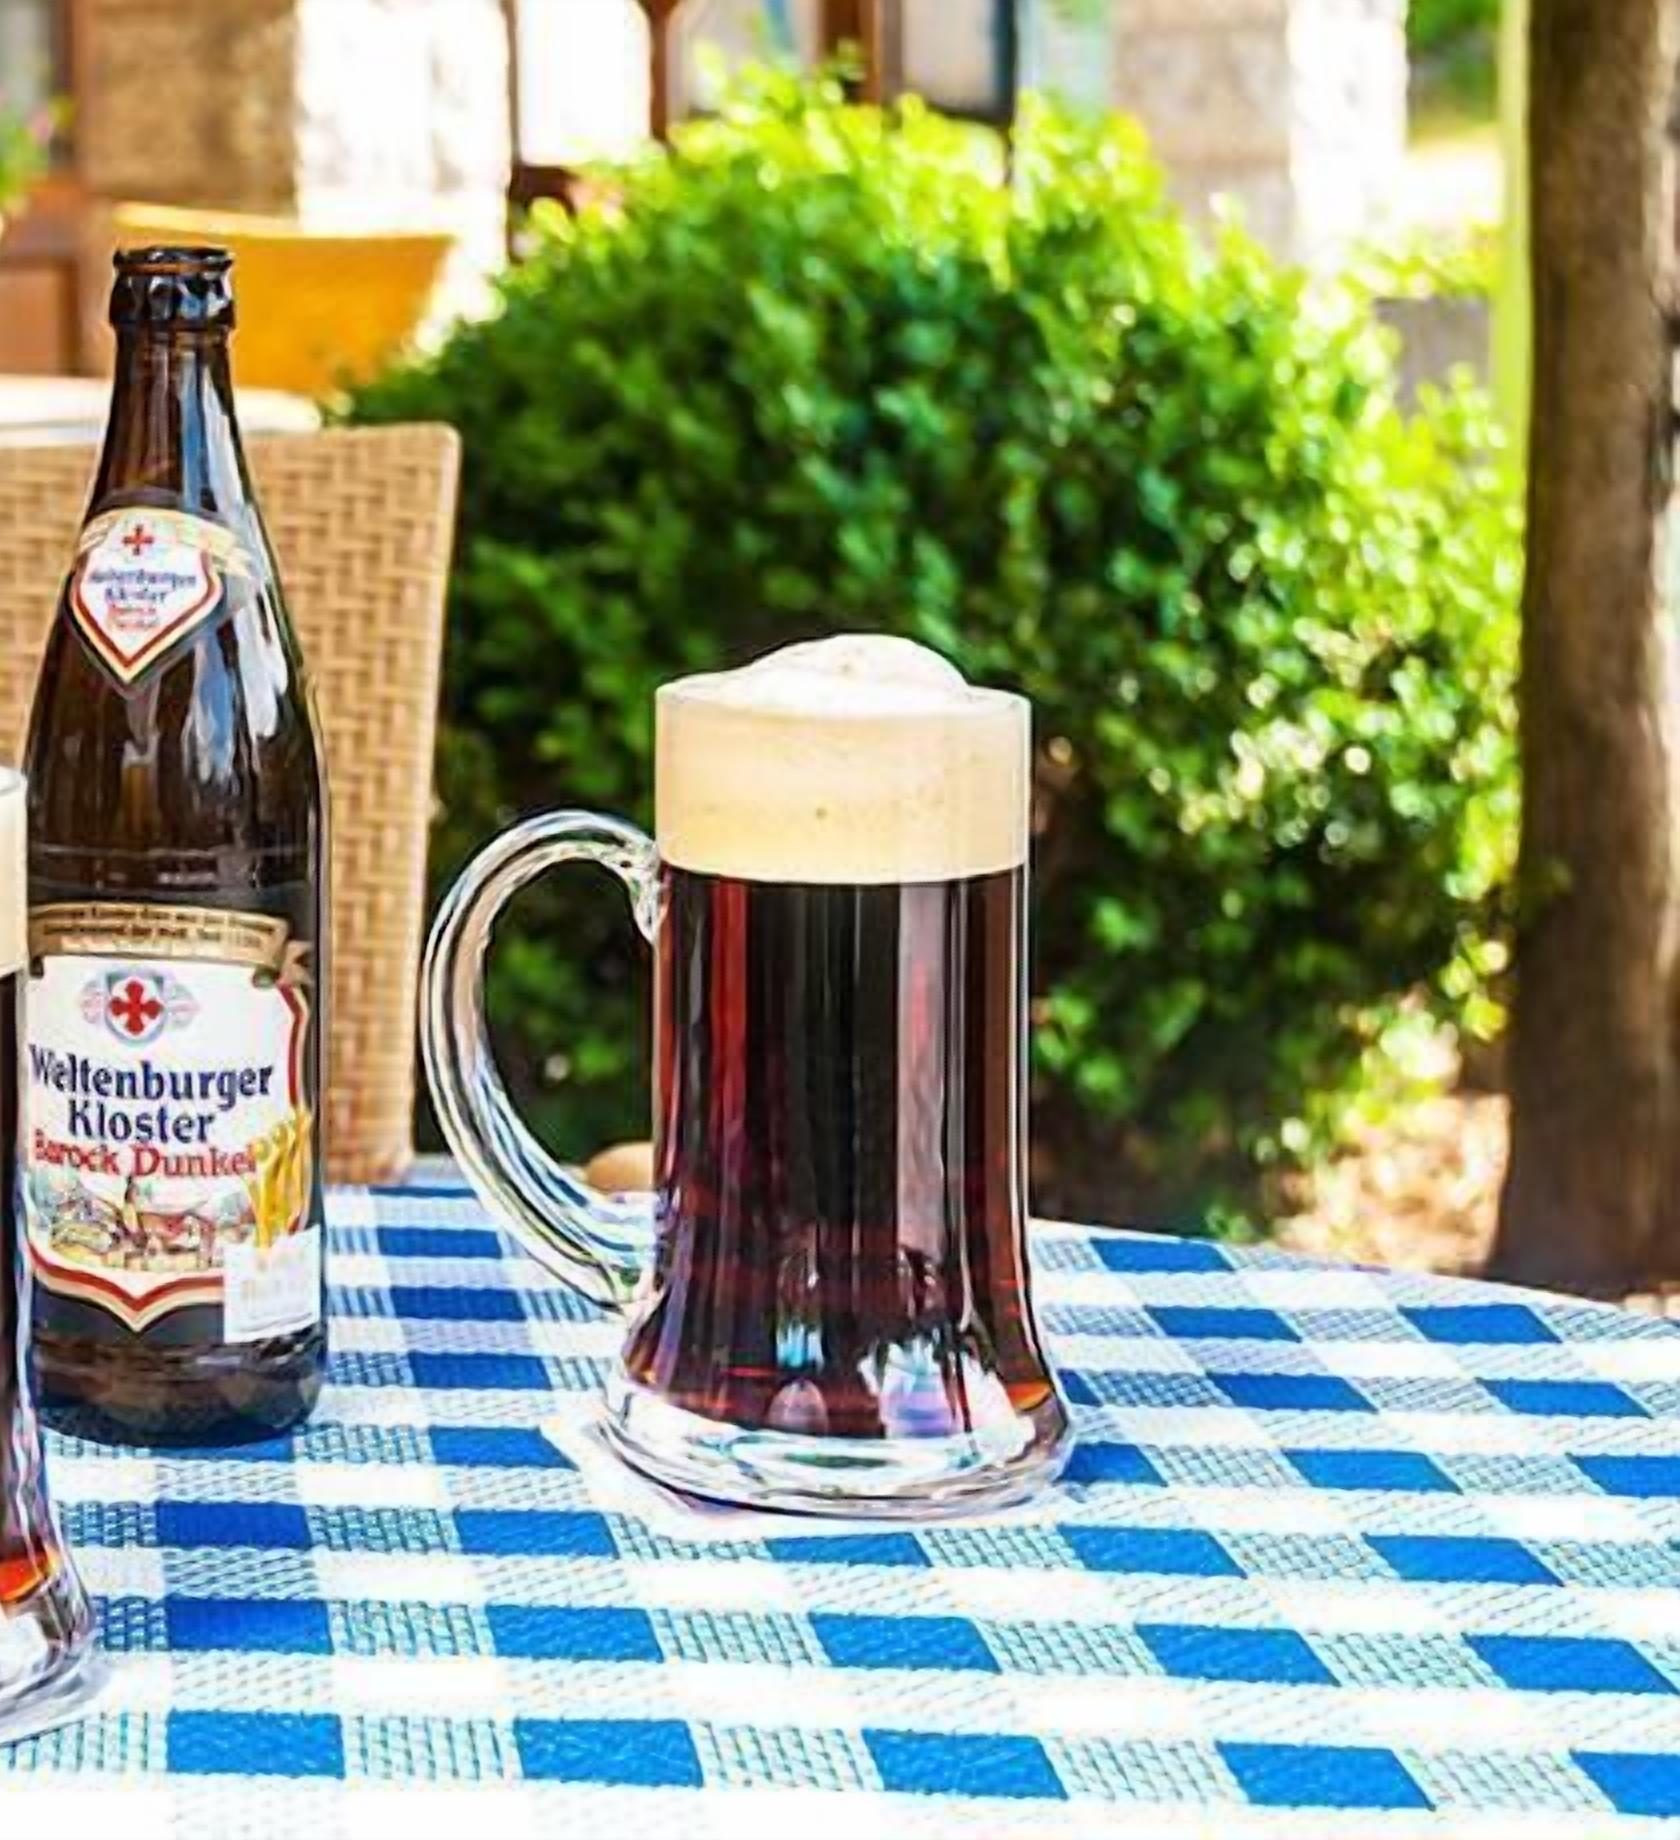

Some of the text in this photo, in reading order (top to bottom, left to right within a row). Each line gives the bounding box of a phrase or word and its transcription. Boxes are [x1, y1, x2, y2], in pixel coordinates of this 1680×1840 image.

[26, 1043, 274, 1112] Weltenburger
[67, 1099, 216, 1144] Kloster
[34, 1128, 258, 1178] Barock Dunkel
